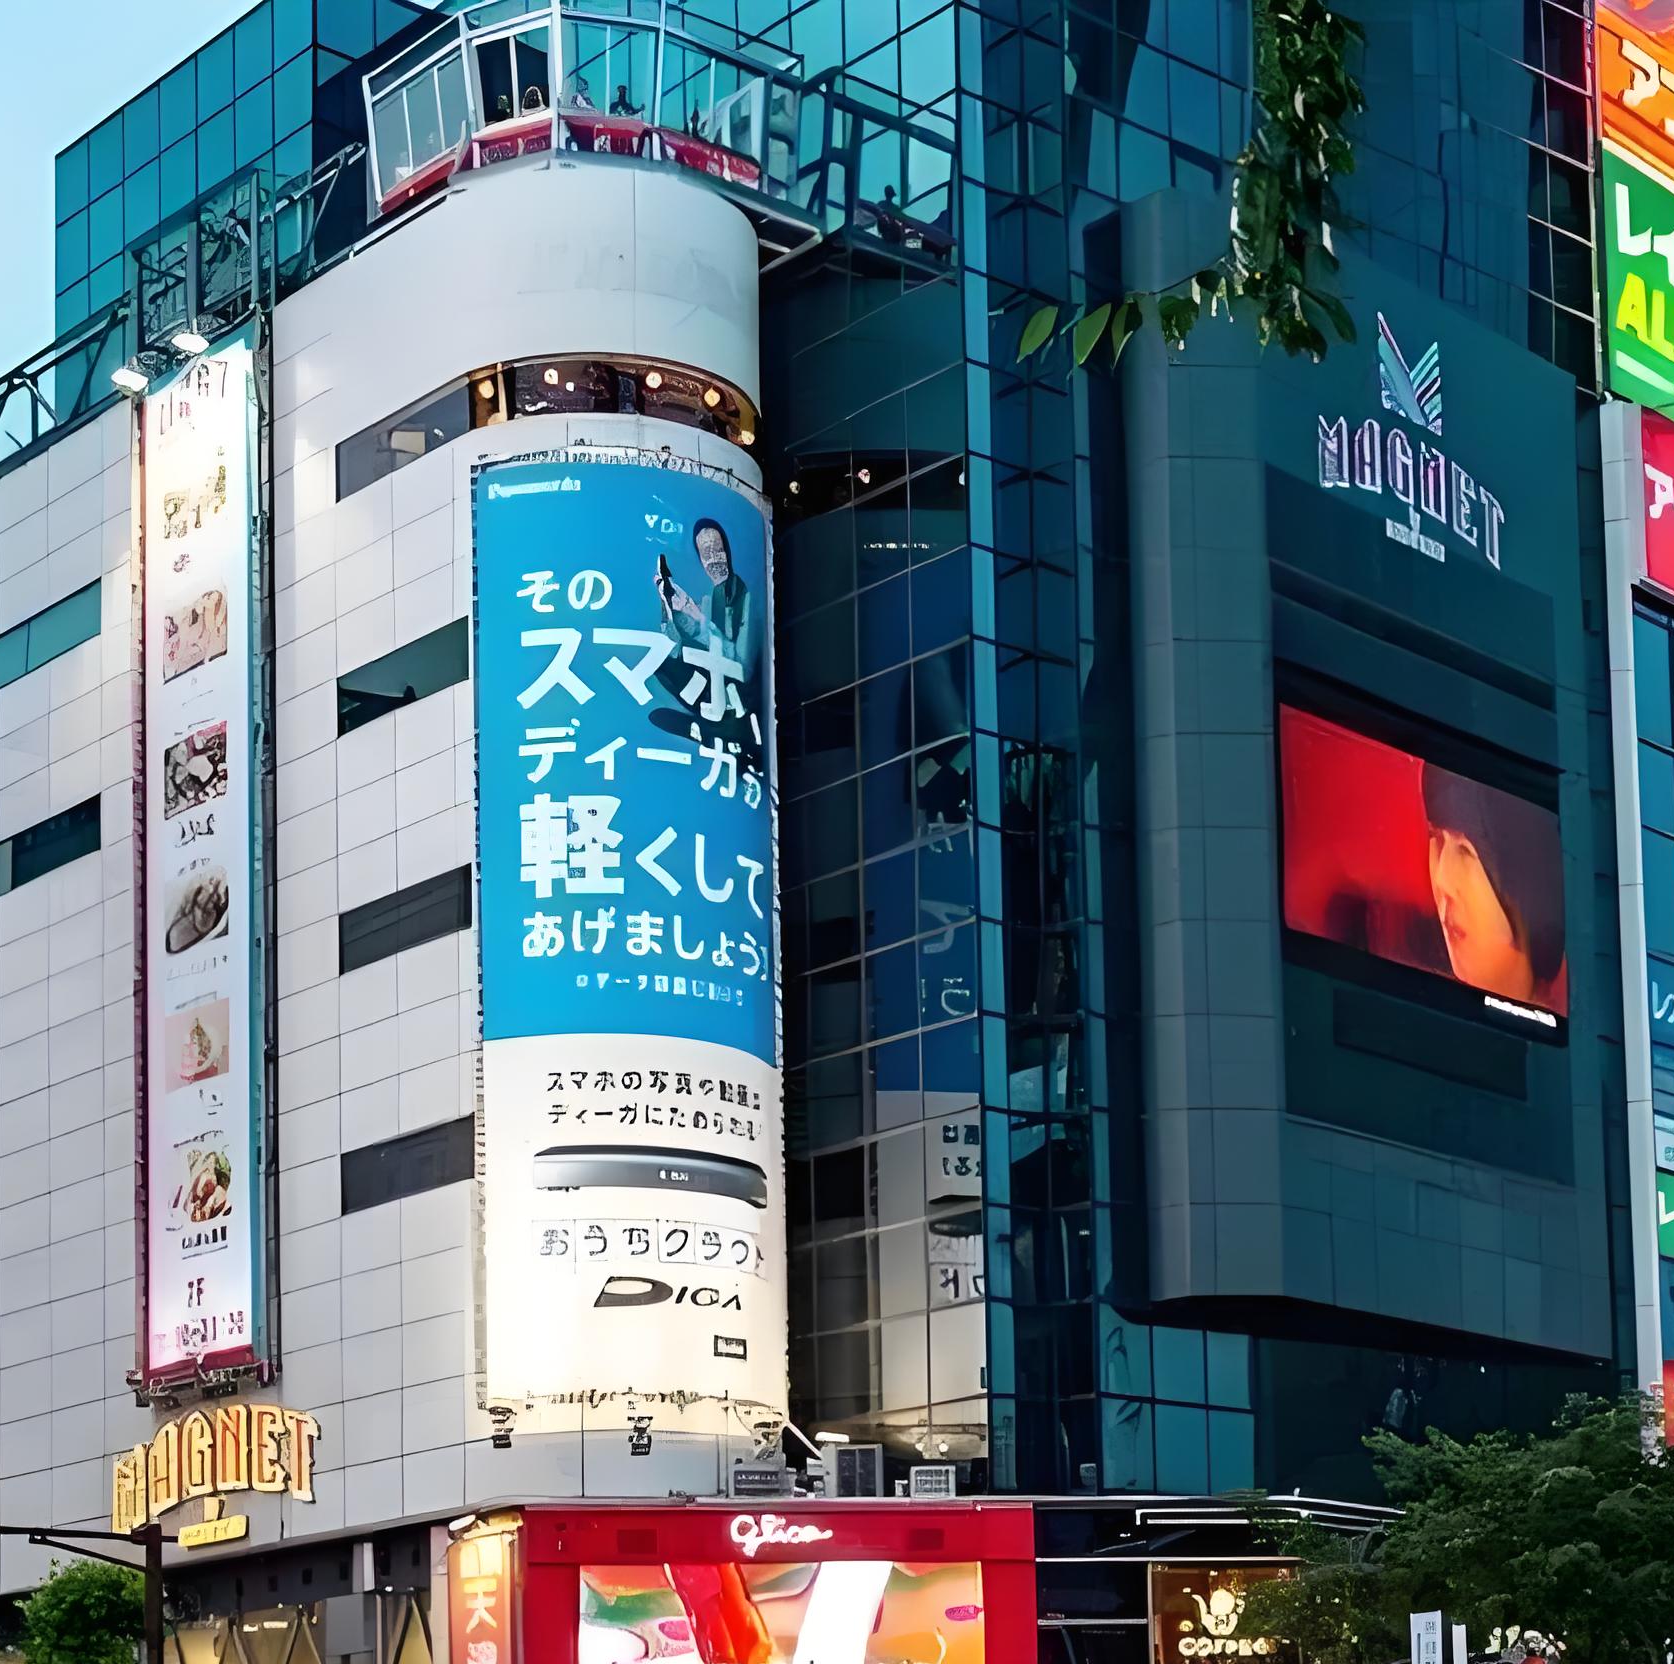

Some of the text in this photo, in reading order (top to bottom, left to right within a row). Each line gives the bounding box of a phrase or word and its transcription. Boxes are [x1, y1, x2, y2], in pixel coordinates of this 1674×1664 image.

[1317, 413, 1506, 571] MAGNET
[516, 570, 613, 613] その
[519, 793, 765, 919] 軽くして
[111, 1403, 321, 1535] MAGNET
